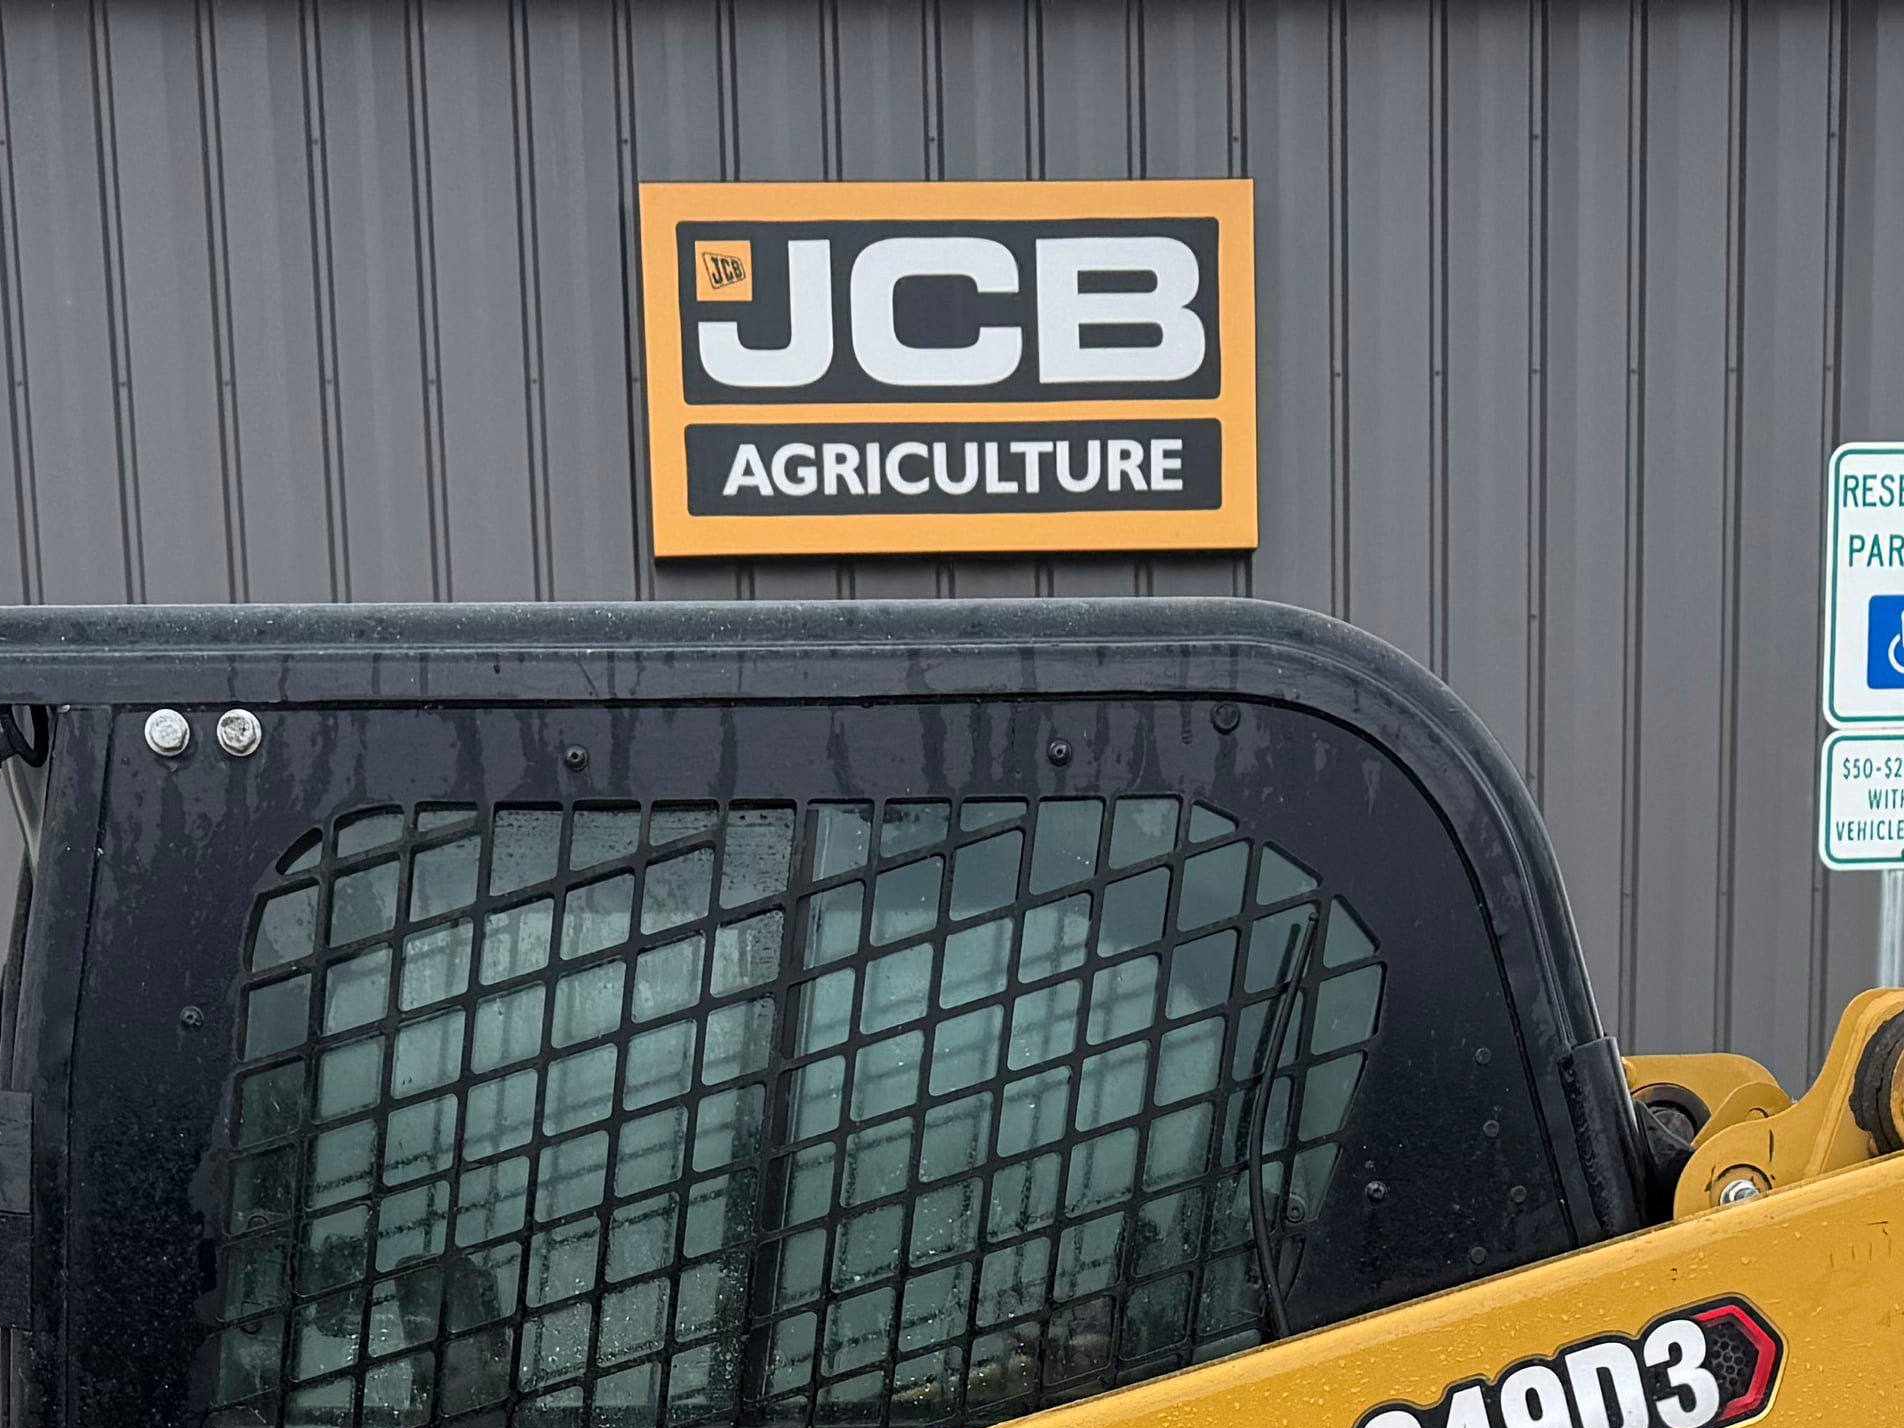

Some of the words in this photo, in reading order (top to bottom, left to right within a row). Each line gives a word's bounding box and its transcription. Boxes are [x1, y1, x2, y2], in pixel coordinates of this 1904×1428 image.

[710, 256, 742, 285] JCB
[697, 236, 1206, 387] JCB
[722, 438, 1184, 497] AGRICULTURE
[1836, 819, 1904, 841] VEHICLE
